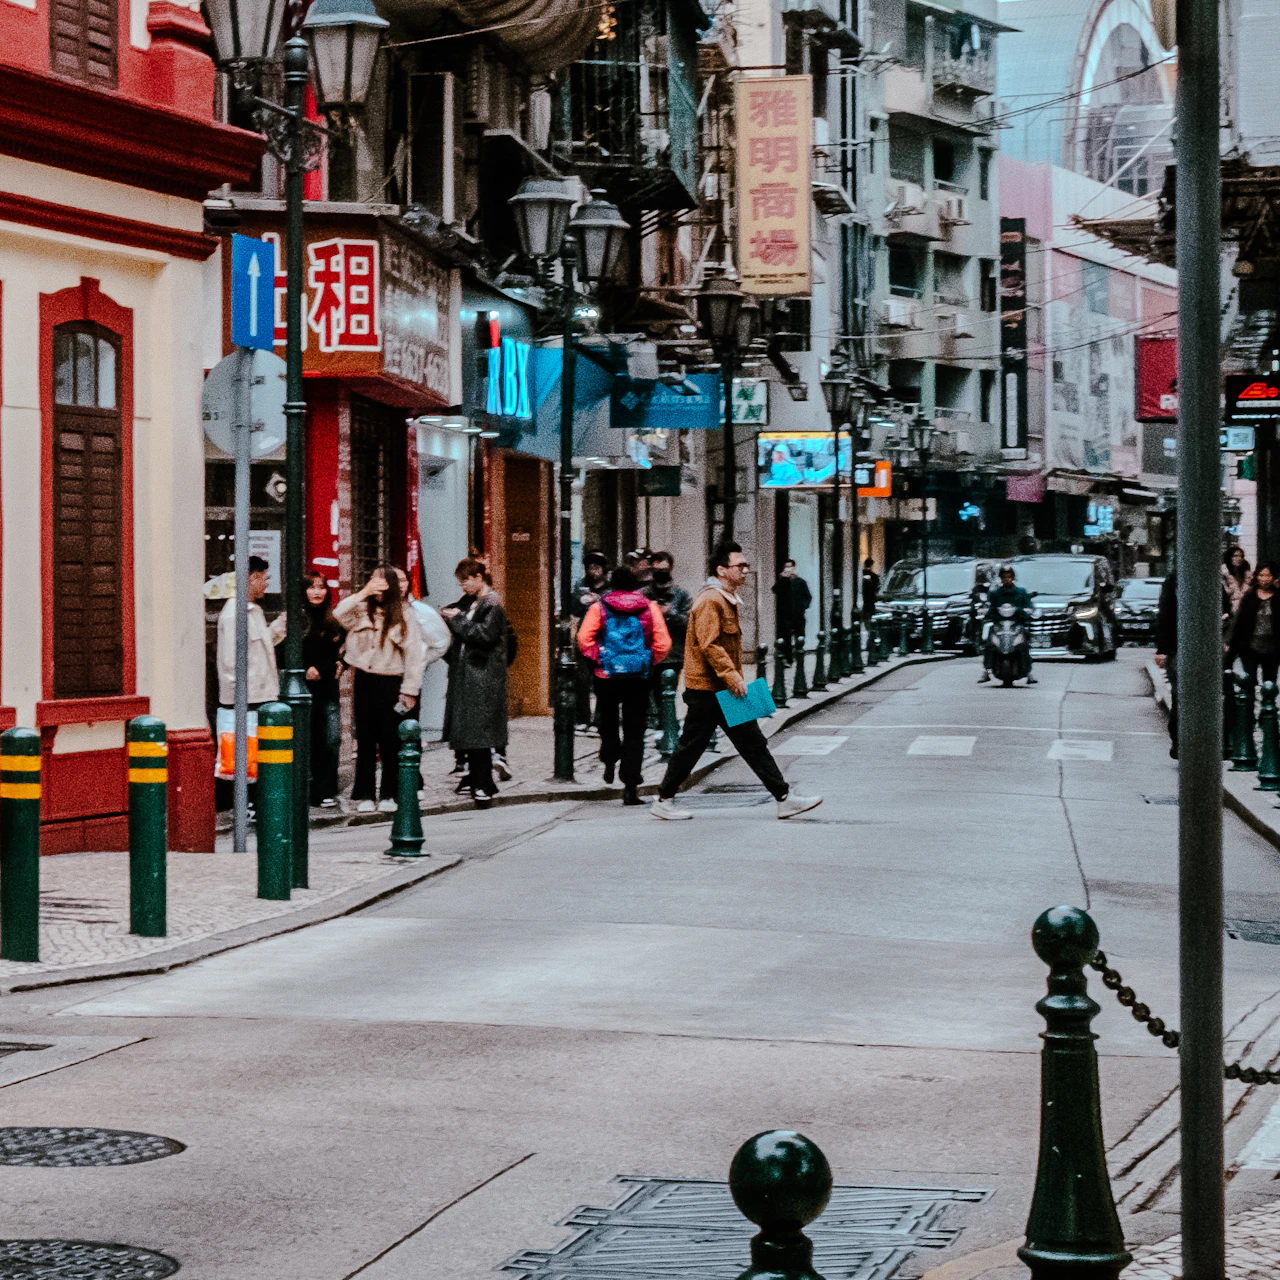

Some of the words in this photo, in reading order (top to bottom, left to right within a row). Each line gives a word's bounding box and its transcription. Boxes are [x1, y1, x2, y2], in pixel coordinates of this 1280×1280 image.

[749, 89, 799, 267] 雅明商場
[261, 231, 382, 353] 租
